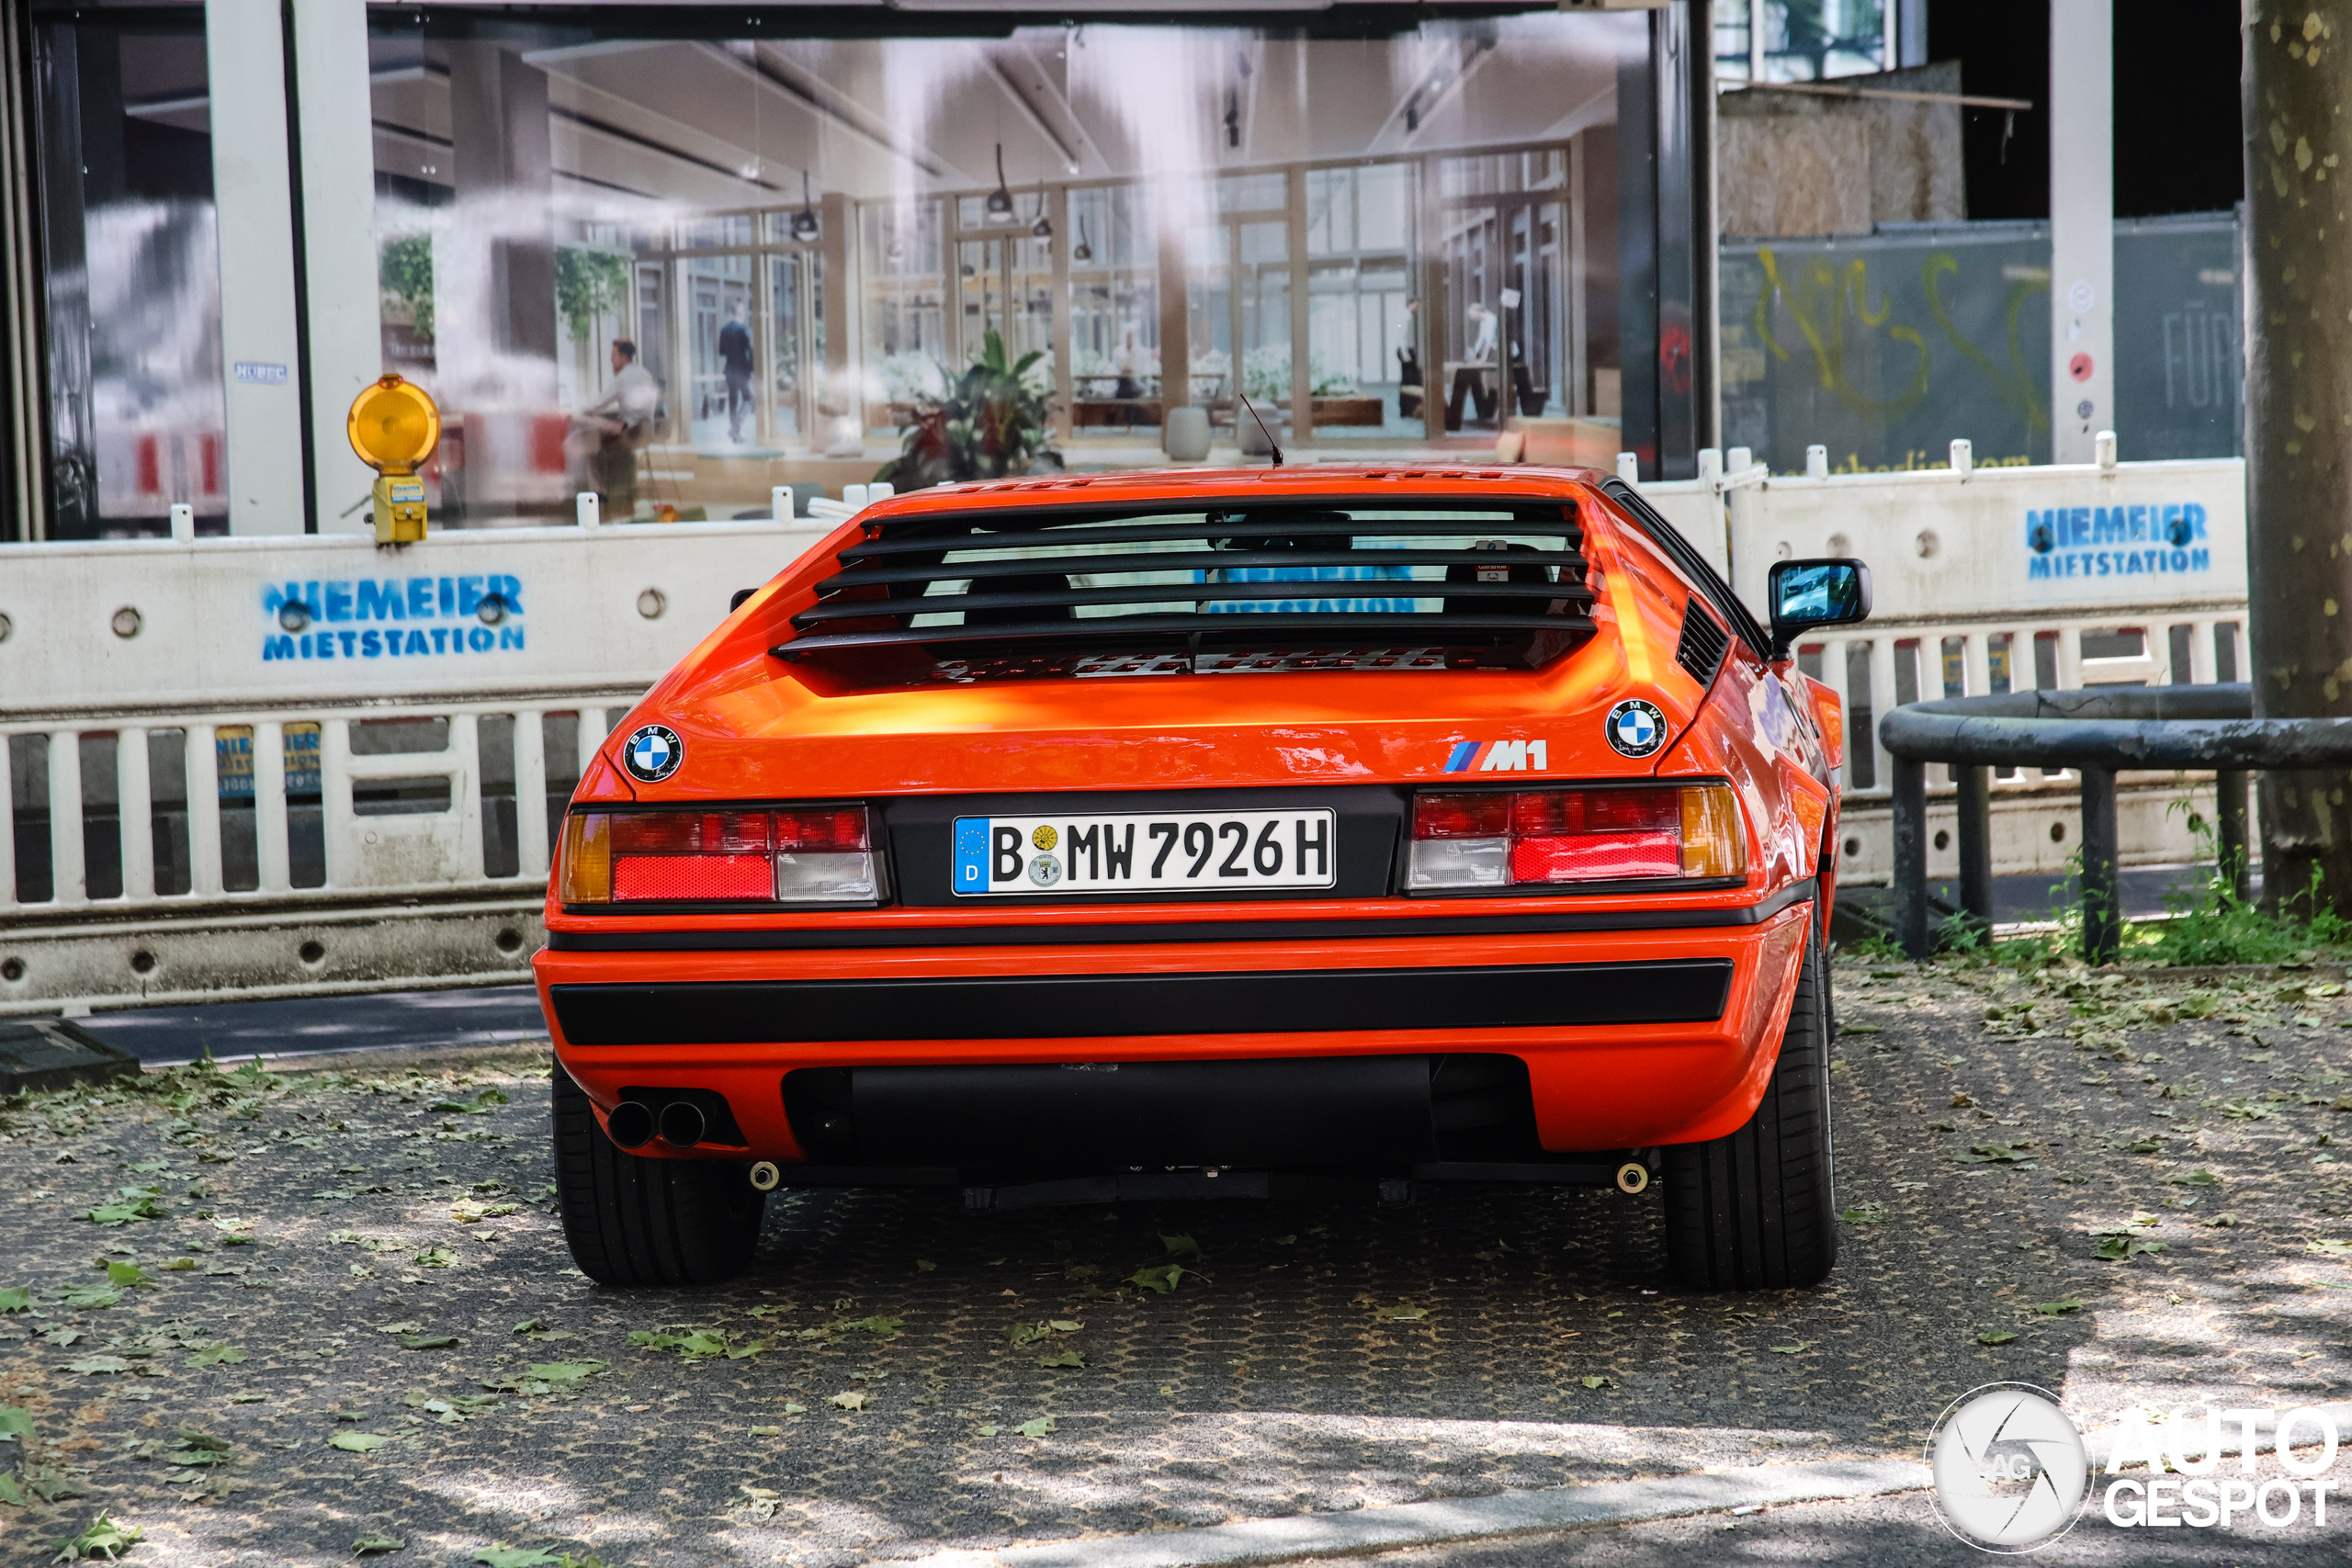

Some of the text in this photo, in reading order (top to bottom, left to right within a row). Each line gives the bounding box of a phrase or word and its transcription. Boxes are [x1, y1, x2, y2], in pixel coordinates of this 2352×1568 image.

[2027, 503, 2208, 548] NIEMEIER
[2028, 548, 2210, 580] MIETSTATION
[263, 574, 524, 623] NIEMEIER
[263, 626, 525, 660] MIETSTATION
[1611, 701, 1661, 720] BMW
[629, 727, 678, 746] BMW
[966, 864, 978, 881] D
